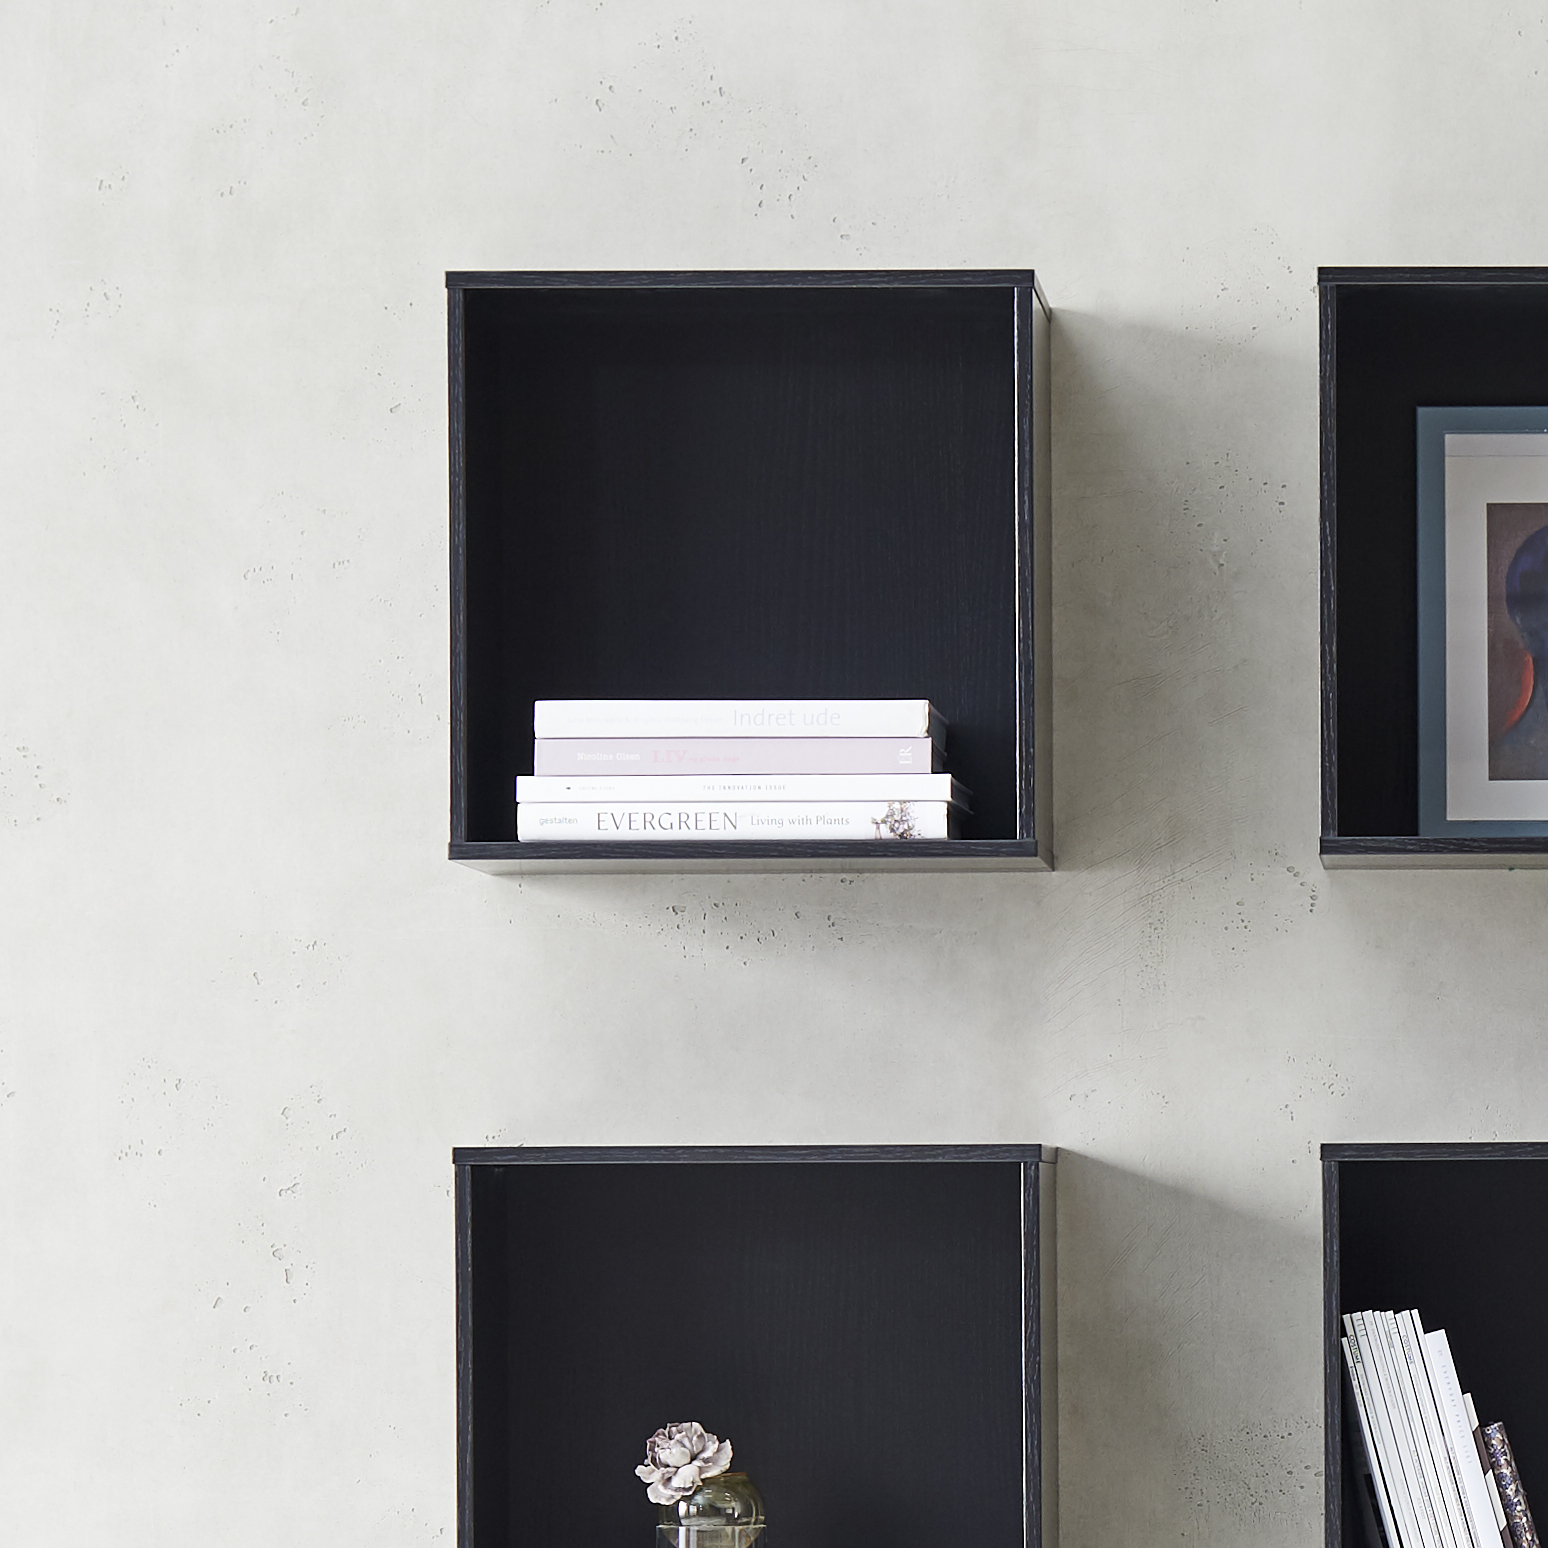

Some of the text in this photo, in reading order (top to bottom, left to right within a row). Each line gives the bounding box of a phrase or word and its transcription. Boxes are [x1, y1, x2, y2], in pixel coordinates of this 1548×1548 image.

[734, 709, 841, 727] Indret ude
[577, 752, 641, 761] Nicoline Olsen
[652, 749, 688, 763] LIV
[539, 815, 578, 826] gestalten
[597, 811, 738, 831] EVERGREEN
[750, 814, 850, 828] Living with Plants
